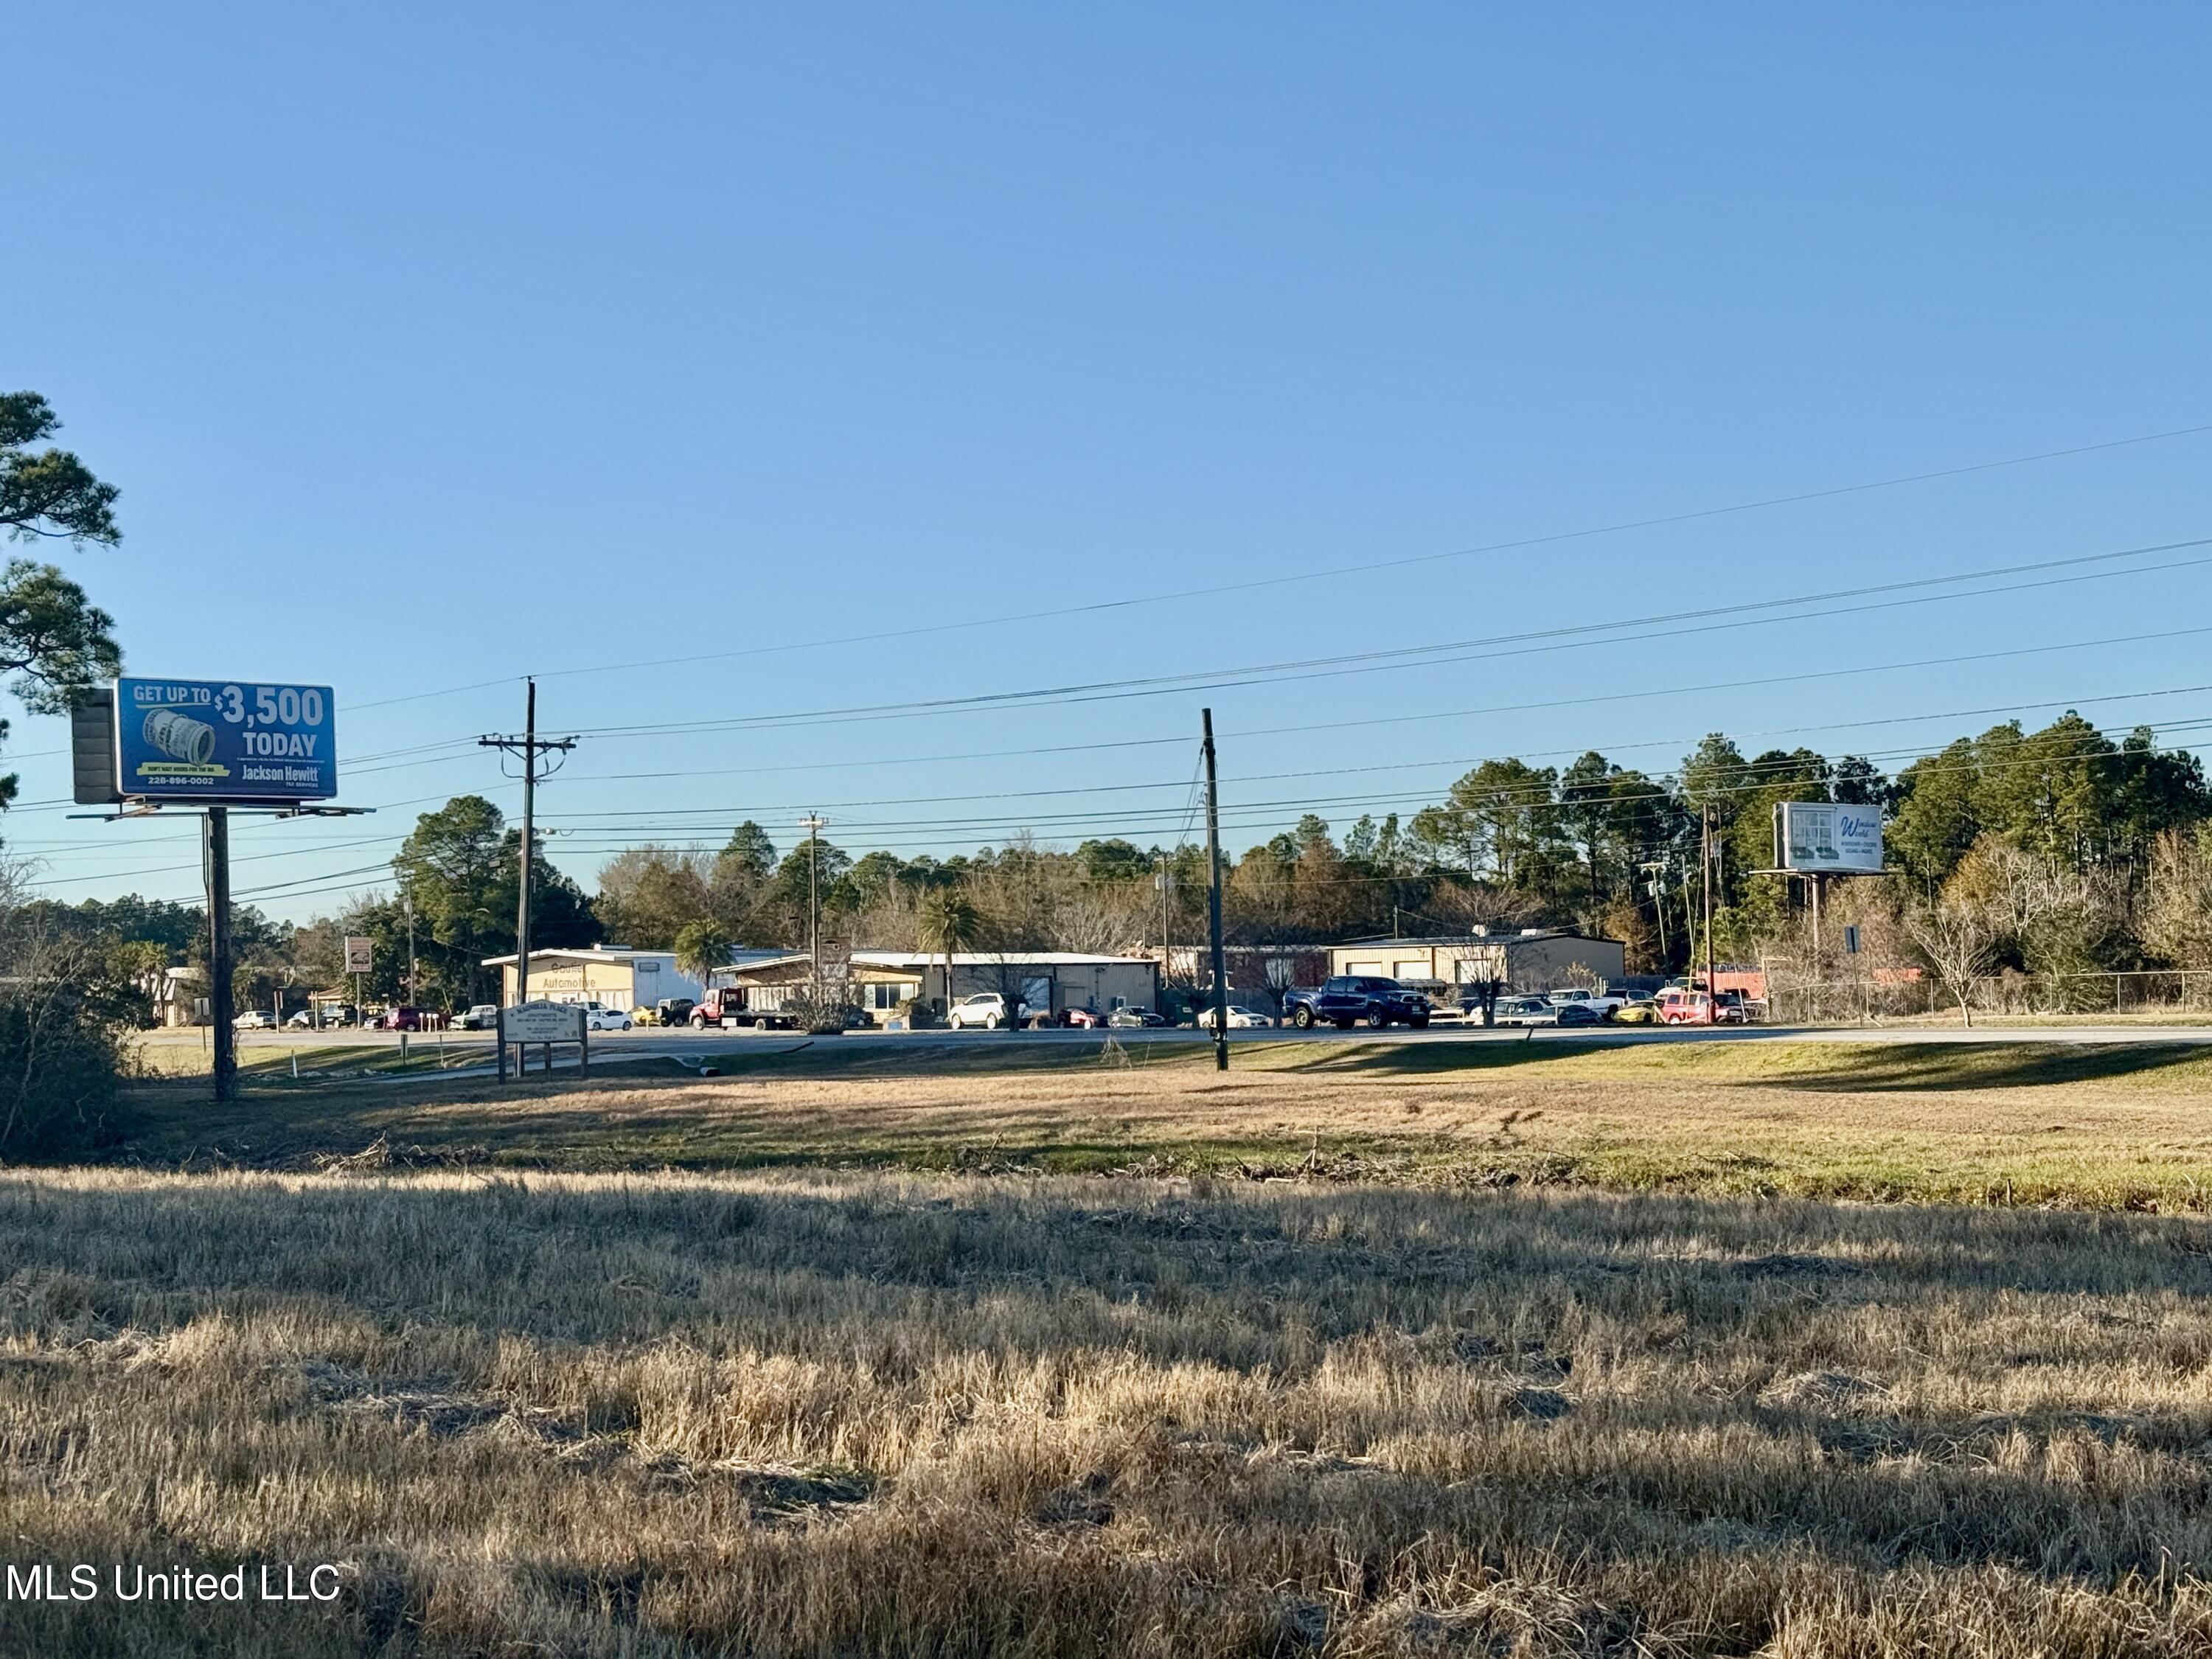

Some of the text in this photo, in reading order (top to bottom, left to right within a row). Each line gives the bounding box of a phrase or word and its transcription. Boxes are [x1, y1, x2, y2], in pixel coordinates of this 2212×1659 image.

[134, 685, 211, 703] GET UP TO
[215, 685, 323, 728] $3,500
[243, 732, 317, 757] TODAY
[148, 776, 214, 785] 228-896-0002
[243, 765, 319, 782] Jackson Hewitt
